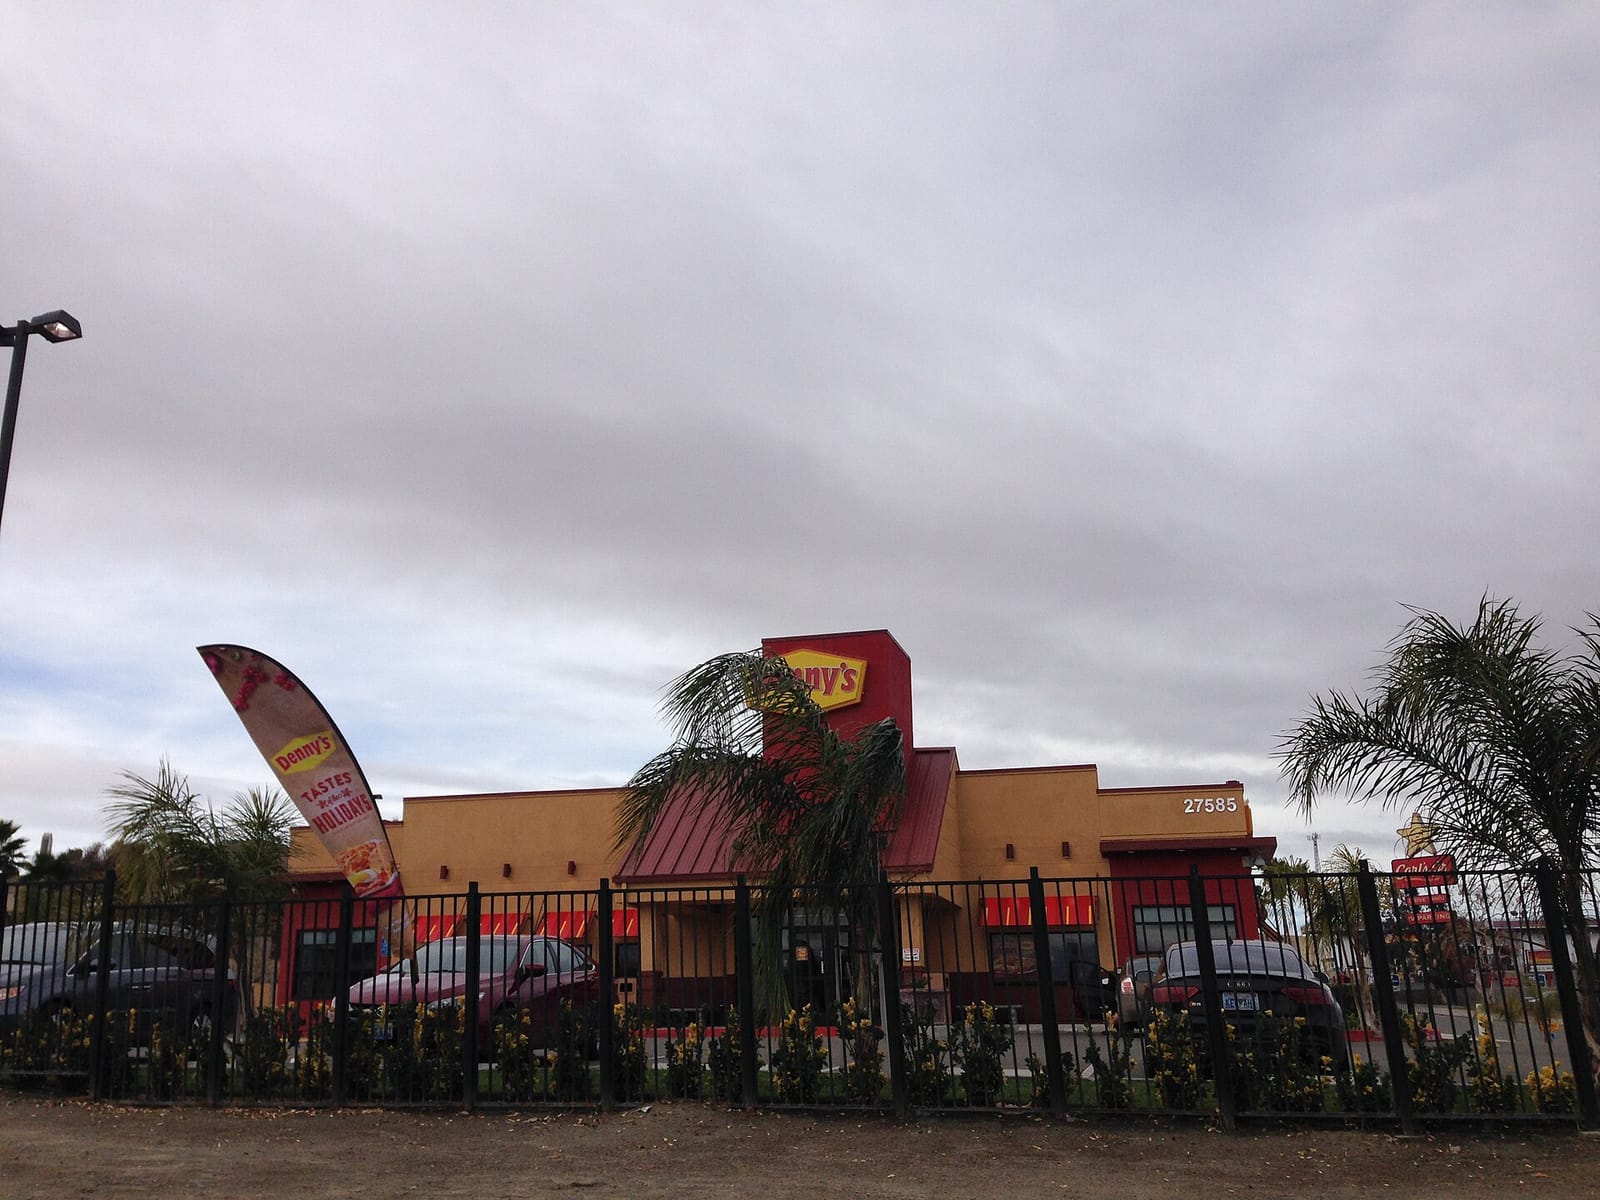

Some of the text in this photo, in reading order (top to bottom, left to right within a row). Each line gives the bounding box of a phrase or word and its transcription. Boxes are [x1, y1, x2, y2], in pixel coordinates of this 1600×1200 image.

[763, 663, 858, 696] ny's
[275, 736, 331, 771] Denny's
[301, 772, 351, 802] TASTES
[312, 794, 372, 834] HOLIDAYS
[1183, 797, 1237, 813] 27585
[1417, 911, 1450, 921] PARING
